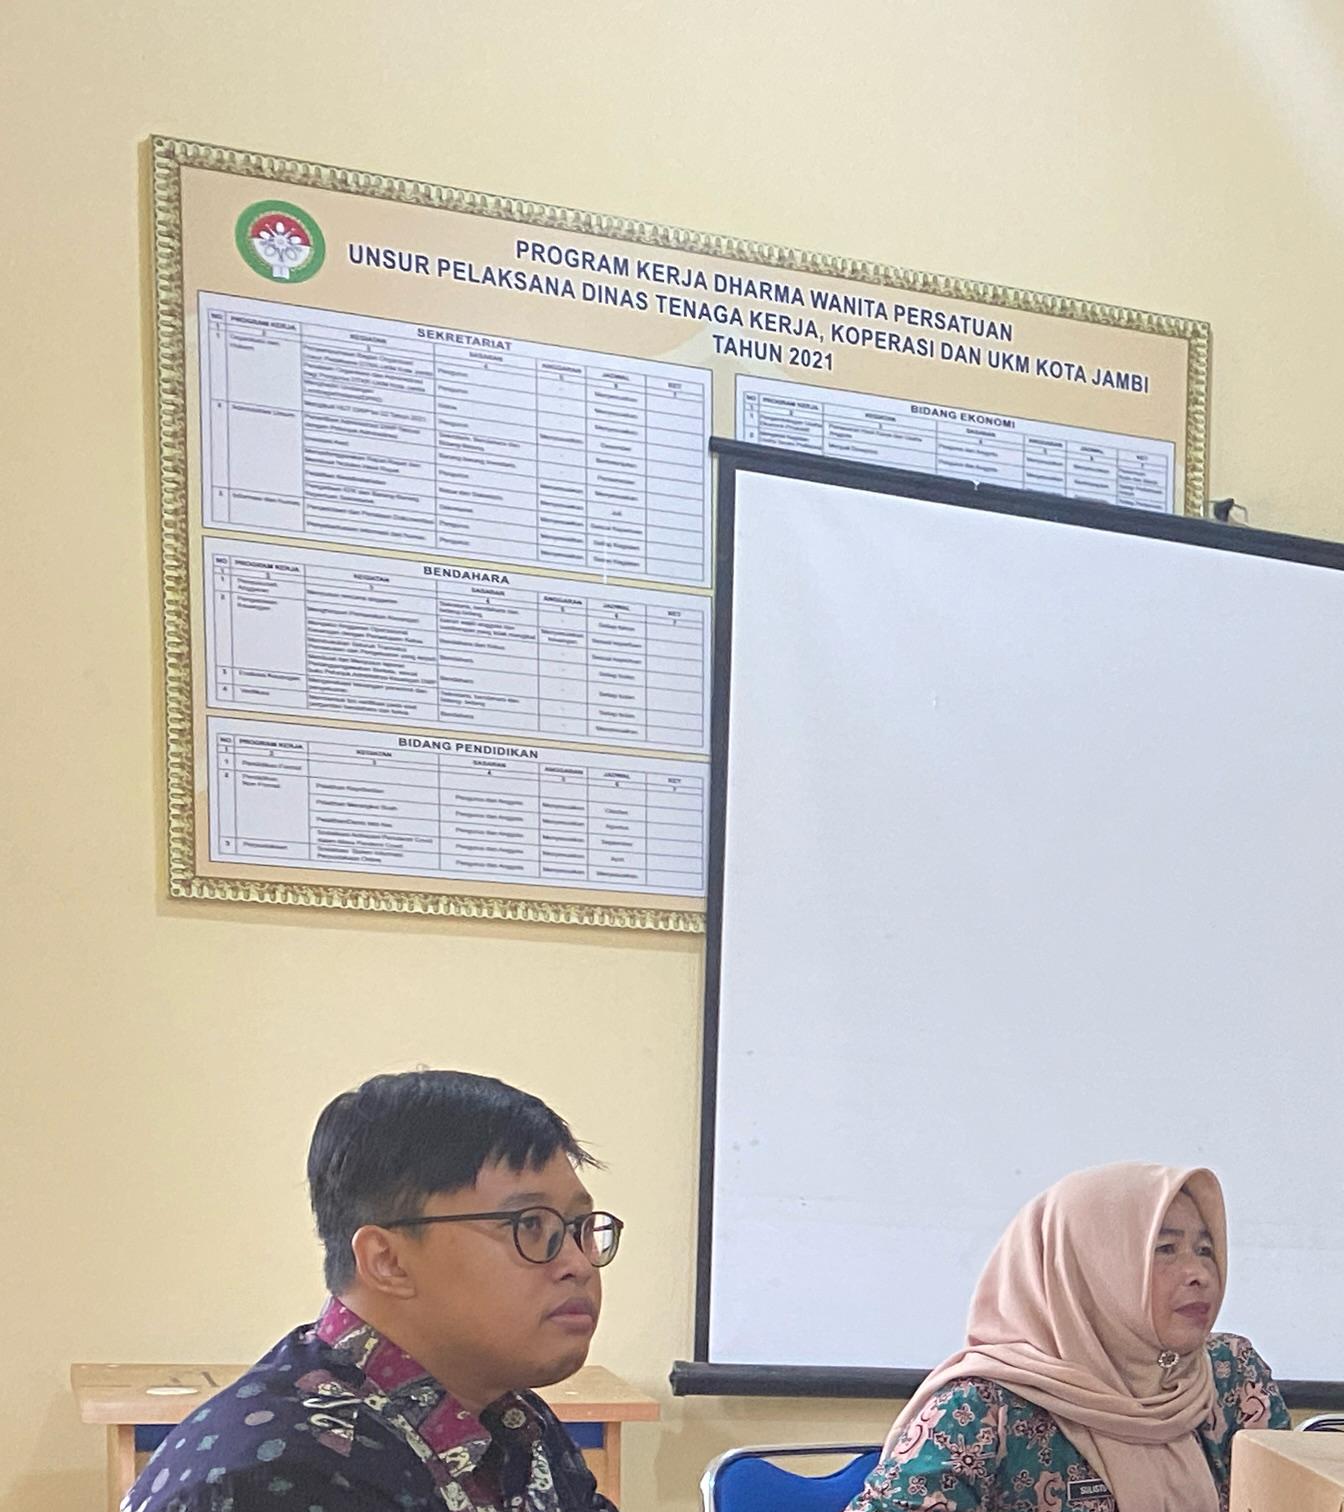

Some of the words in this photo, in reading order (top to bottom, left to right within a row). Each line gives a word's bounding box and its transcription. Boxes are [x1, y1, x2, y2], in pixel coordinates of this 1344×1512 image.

[516, 239, 629, 277] PROGRAM
[637, 260, 708, 290] KERJA
[714, 273, 805, 307] DHARMA
[810, 290, 888, 321] WANITA
[894, 304, 1013, 342] PERSATUAN
[349, 243, 430, 275] UNSUR
[438, 258, 576, 299] PELAKSANA
[582, 282, 648, 311] DINAS
[655, 294, 744, 327] TENAGA
[750, 310, 825, 343] KERJA,
[831, 323, 935, 358] KOPERASI
[941, 342, 981, 366] DAN
[988, 350, 1030, 374] UKM
[1036, 358, 1087, 383] KOTA
[1091, 368, 1149, 393] JAMBI
[417, 327, 512, 350] SEKRETARIAT
[712, 334, 782, 363] TAHUN
[789, 347, 833, 371] 2021
[910, 404, 957, 420] BIDANG
[960, 412, 1016, 429] EKONOMI
[423, 566, 510, 585] BENDAHARA
[398, 736, 453, 751] BIDANG
[455, 742, 539, 759] PENDIDIKAN
